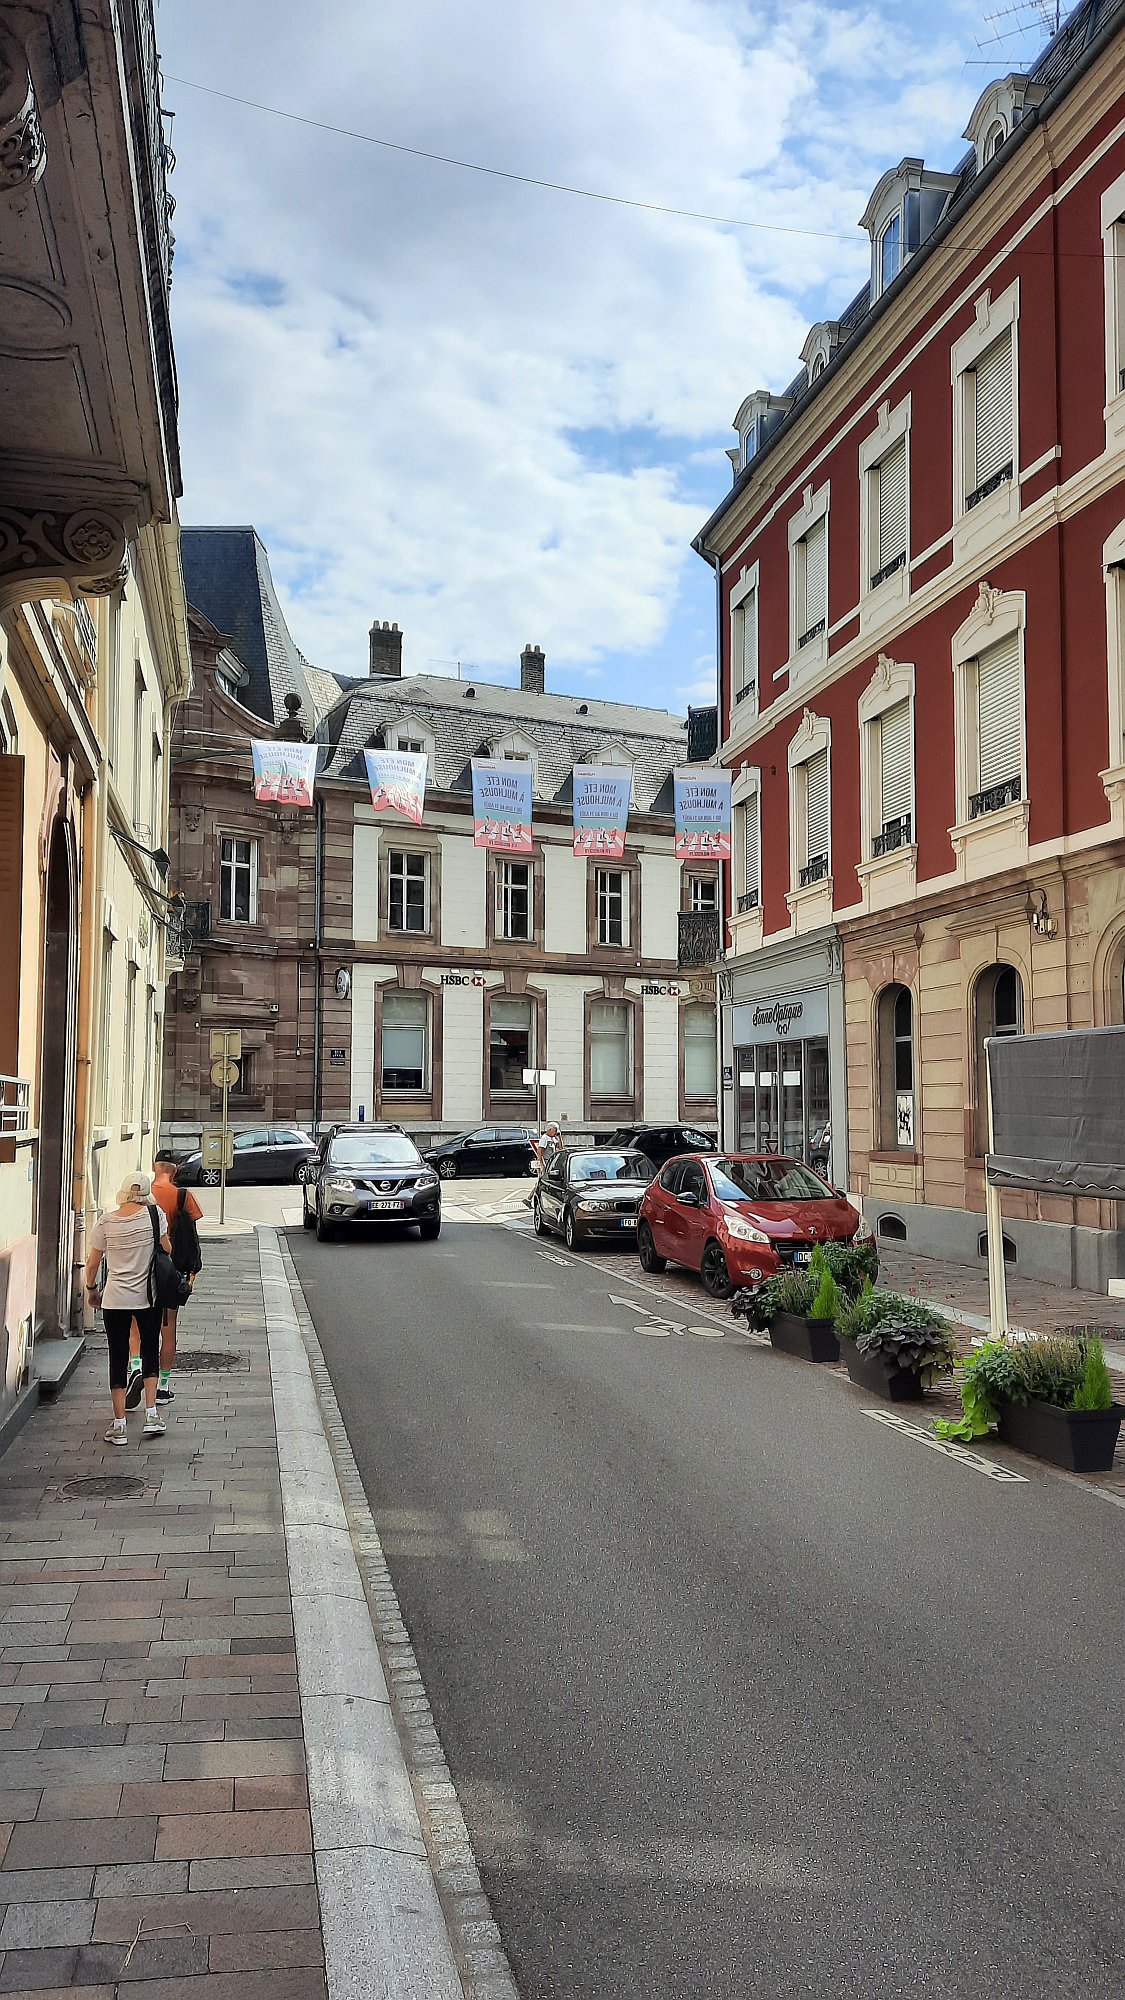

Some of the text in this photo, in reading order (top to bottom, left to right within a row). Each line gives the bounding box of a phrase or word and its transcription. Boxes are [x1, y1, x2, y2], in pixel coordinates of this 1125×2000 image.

[441, 976, 469, 985] HSBC
[641, 985, 666, 995] HSBC
[872, 1410, 1021, 1480] PAYANT
